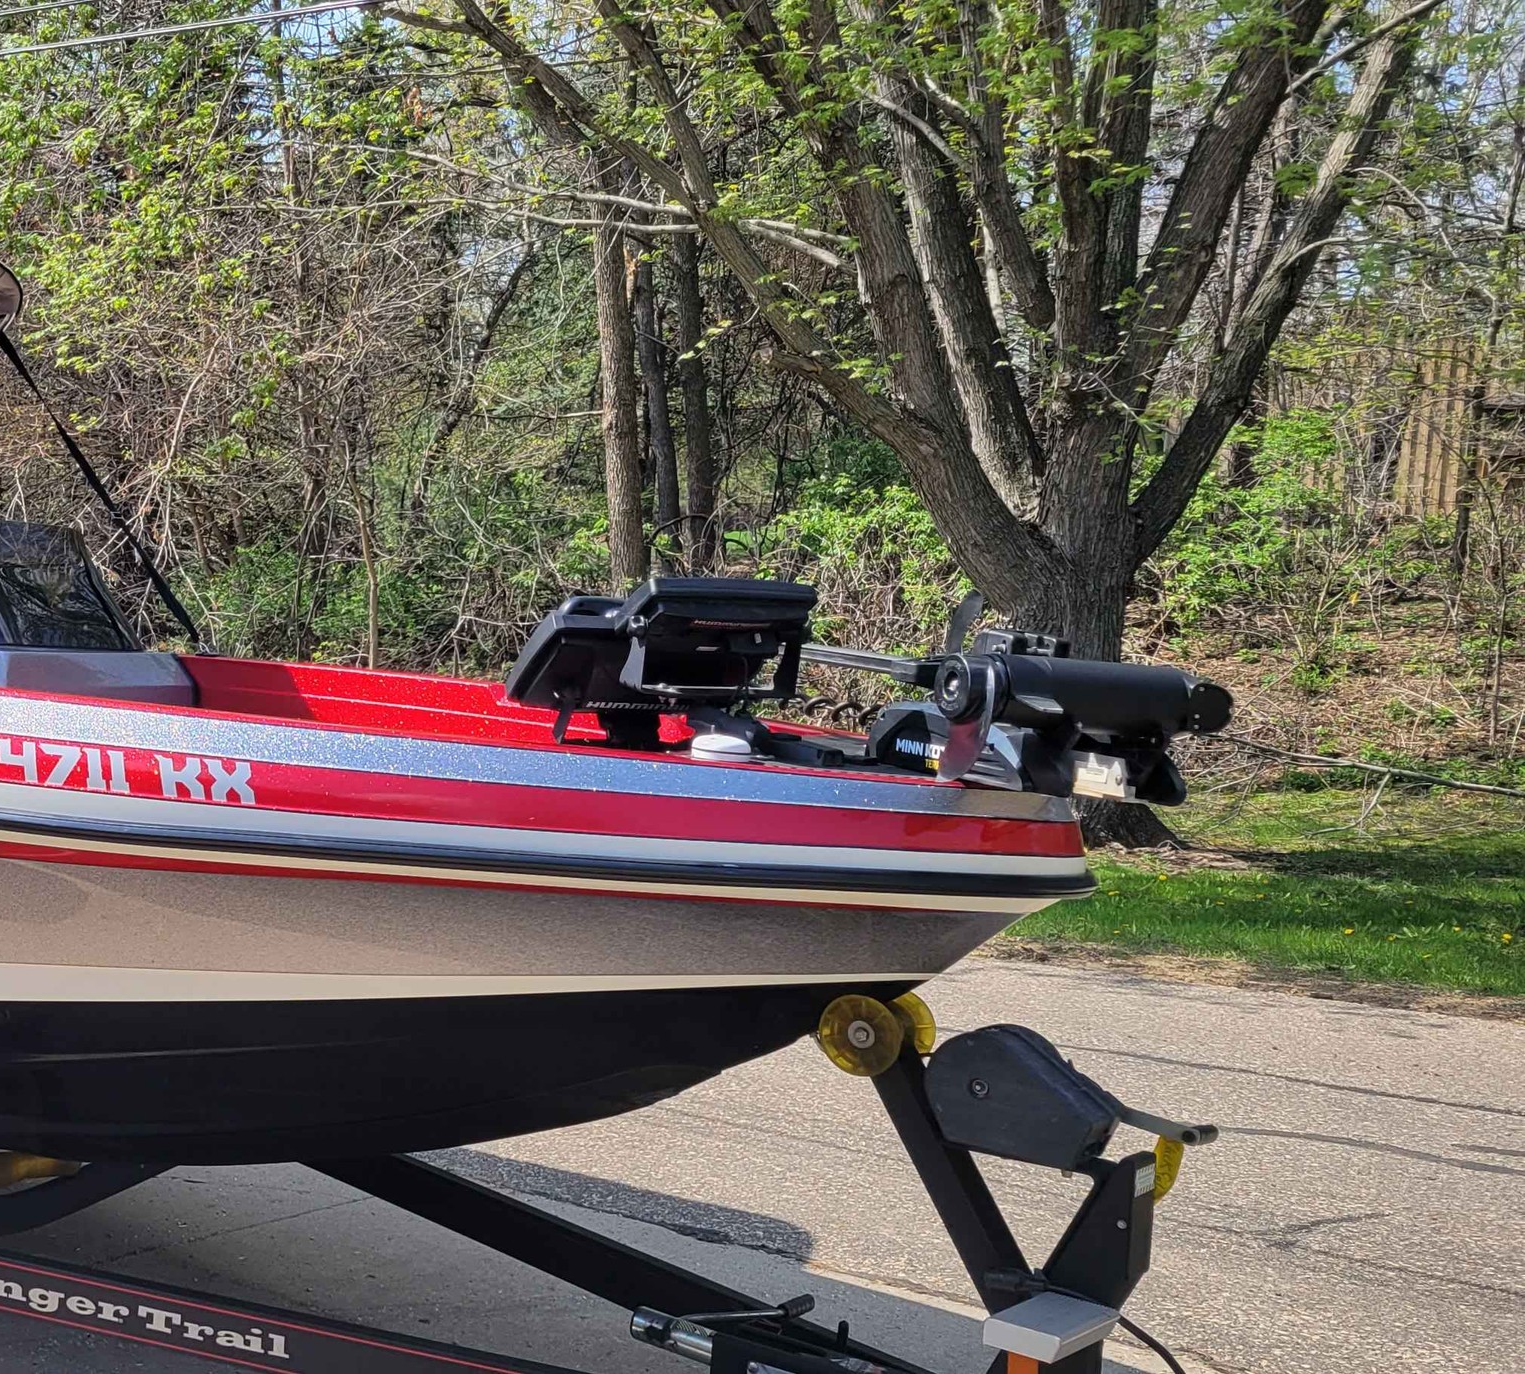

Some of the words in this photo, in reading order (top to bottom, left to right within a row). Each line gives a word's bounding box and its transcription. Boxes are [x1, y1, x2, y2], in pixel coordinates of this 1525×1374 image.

[585, 700, 691, 711] HUMMIN
[895, 738, 924, 757] MINN
[156, 754, 257, 805] KX
[136, 1304, 290, 1359] Trail
